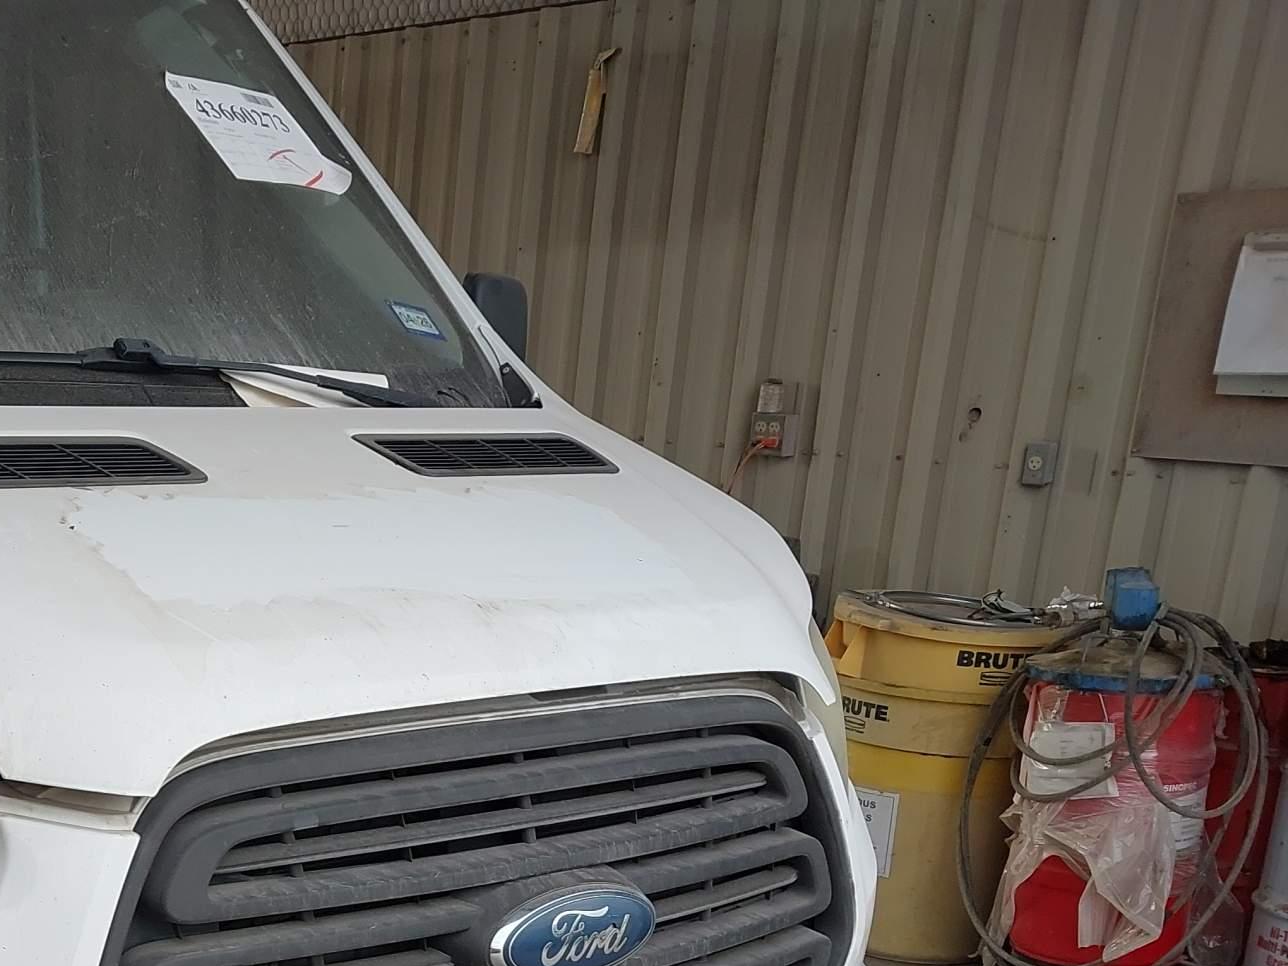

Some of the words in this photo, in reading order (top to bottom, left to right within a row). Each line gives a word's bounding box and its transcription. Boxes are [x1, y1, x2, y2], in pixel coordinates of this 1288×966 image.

[195, 98, 290, 133] 43660273
[842, 696, 888, 722] RUTE
[541, 906, 631, 966] Ford
